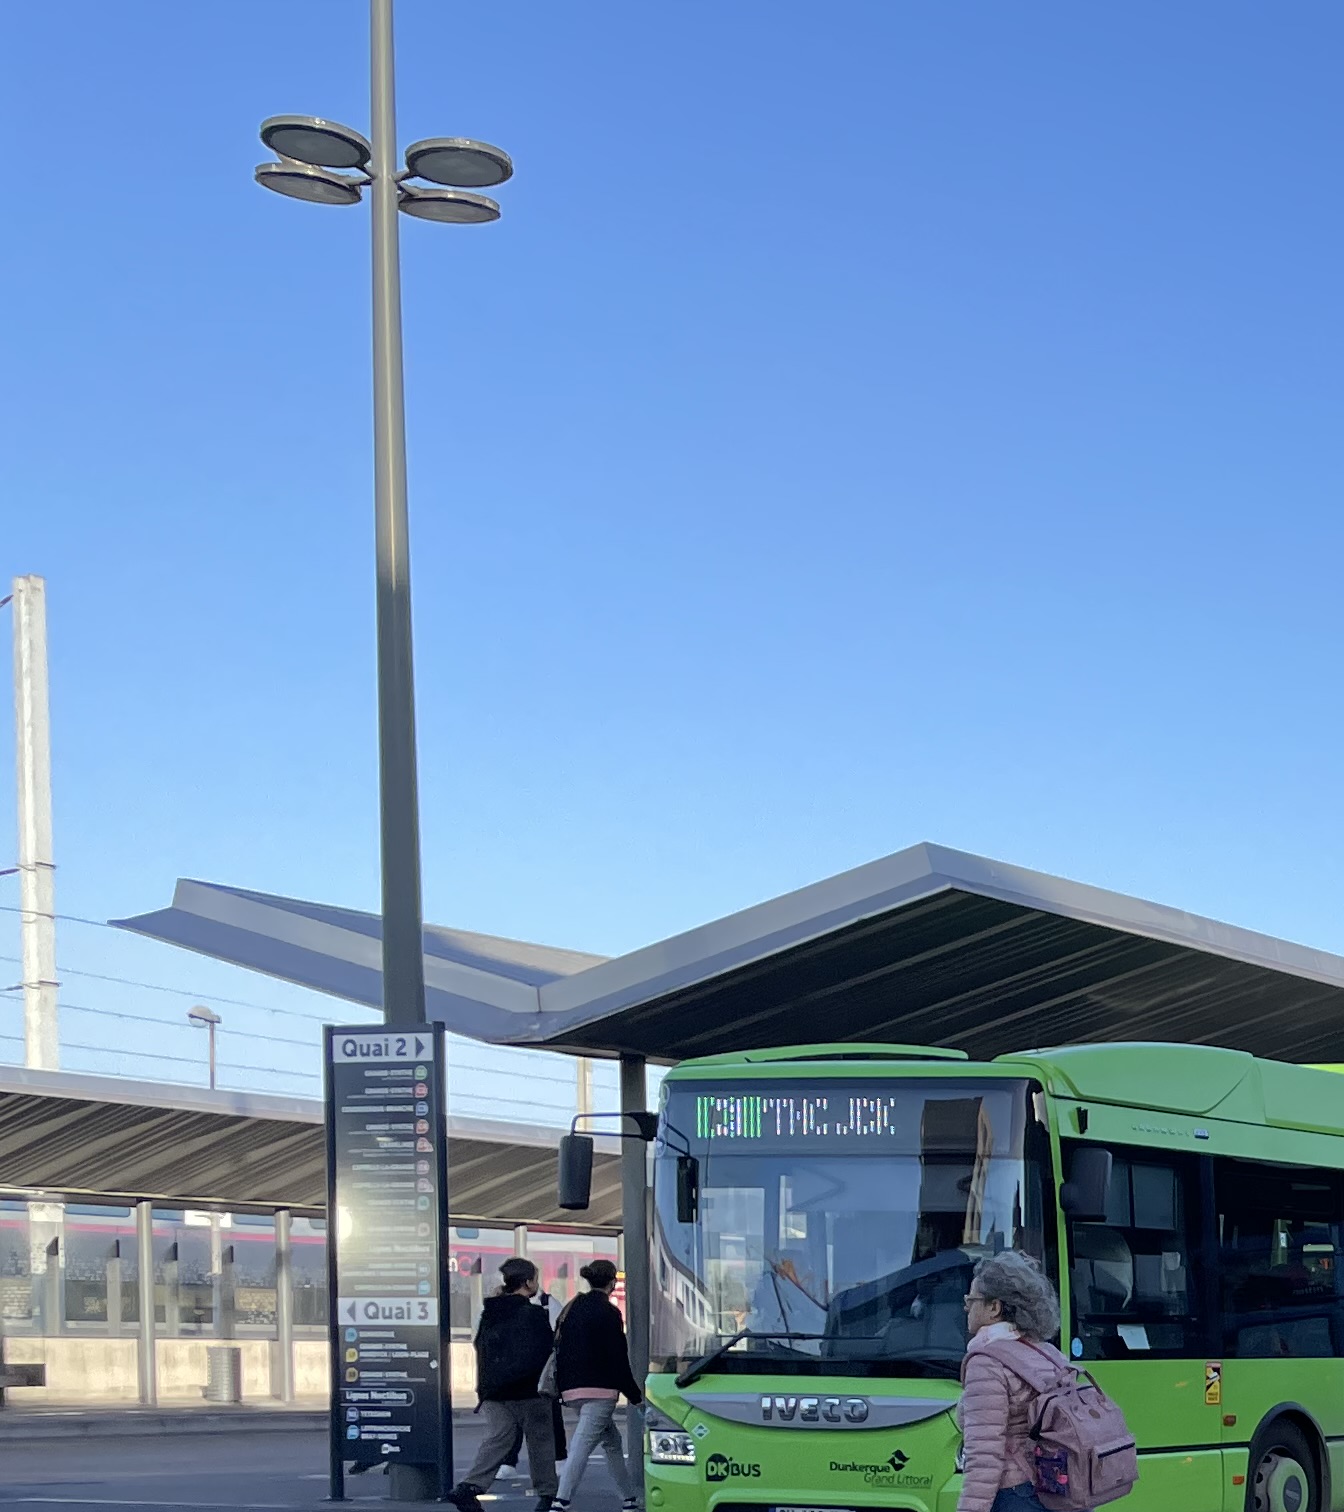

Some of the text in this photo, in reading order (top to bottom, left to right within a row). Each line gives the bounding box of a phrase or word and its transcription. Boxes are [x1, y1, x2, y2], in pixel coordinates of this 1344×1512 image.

[342, 1037, 407, 1057] Quai 2
[363, 1301, 429, 1321] Quai 3
[760, 1396, 869, 1423] IVECO
[829, 1461, 891, 1474] Dunkerque
[863, 1473, 934, 1485] Grand Littoral
